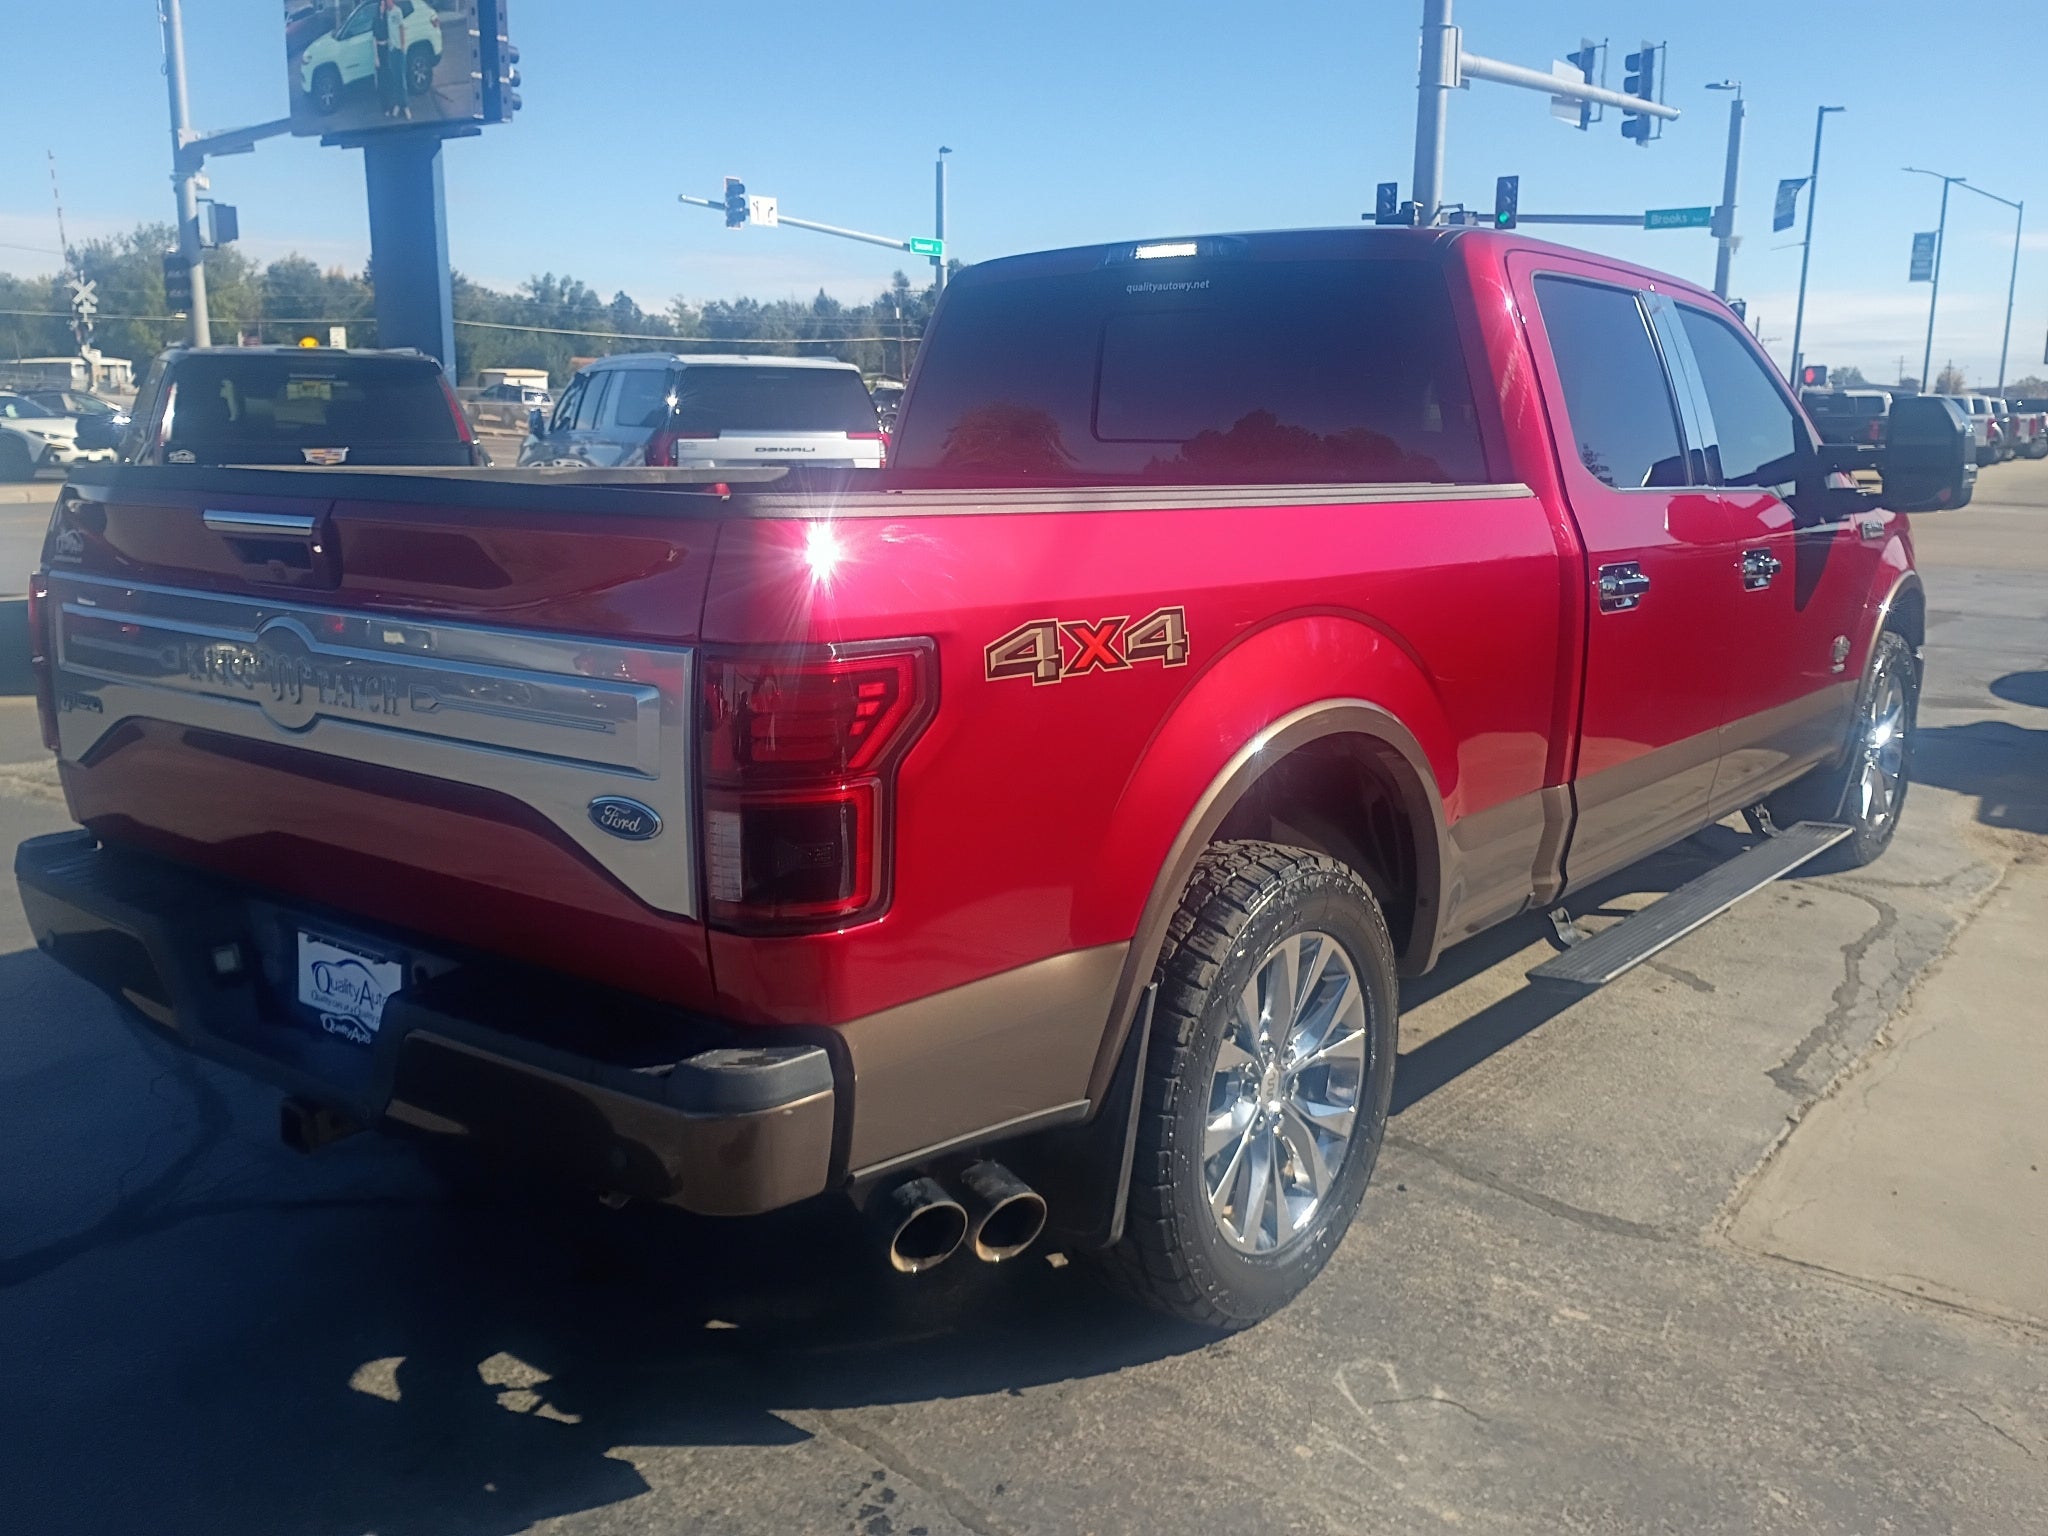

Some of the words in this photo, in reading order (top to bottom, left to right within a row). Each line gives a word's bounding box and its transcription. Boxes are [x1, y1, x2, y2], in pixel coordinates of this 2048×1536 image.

[1126, 280, 1209, 294] qualityautowy.net
[318, 671, 400, 716] RANCH
[601, 804, 641, 832] Ford
